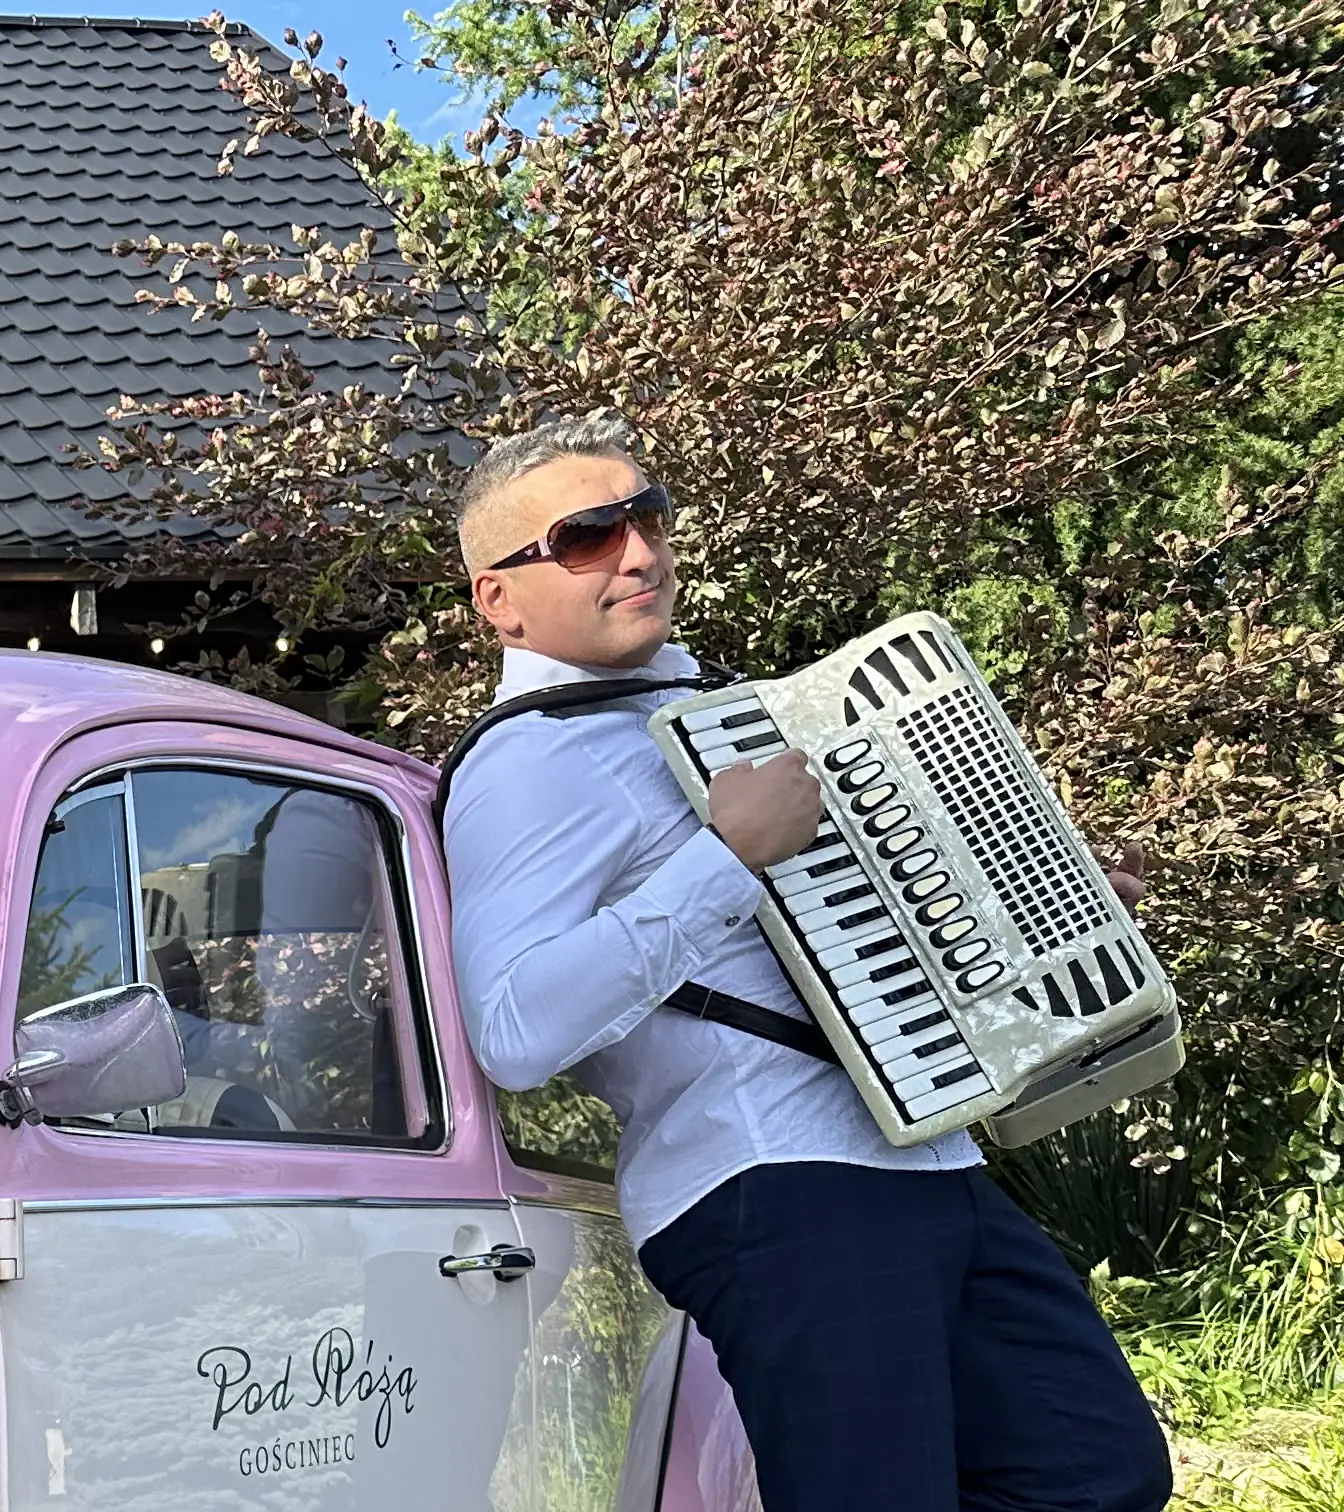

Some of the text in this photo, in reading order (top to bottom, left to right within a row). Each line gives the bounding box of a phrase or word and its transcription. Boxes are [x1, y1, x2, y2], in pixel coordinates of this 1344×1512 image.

[197, 1326, 418, 1449] Pod Różą
[239, 1433, 356, 1476] GOŚCINIEC
